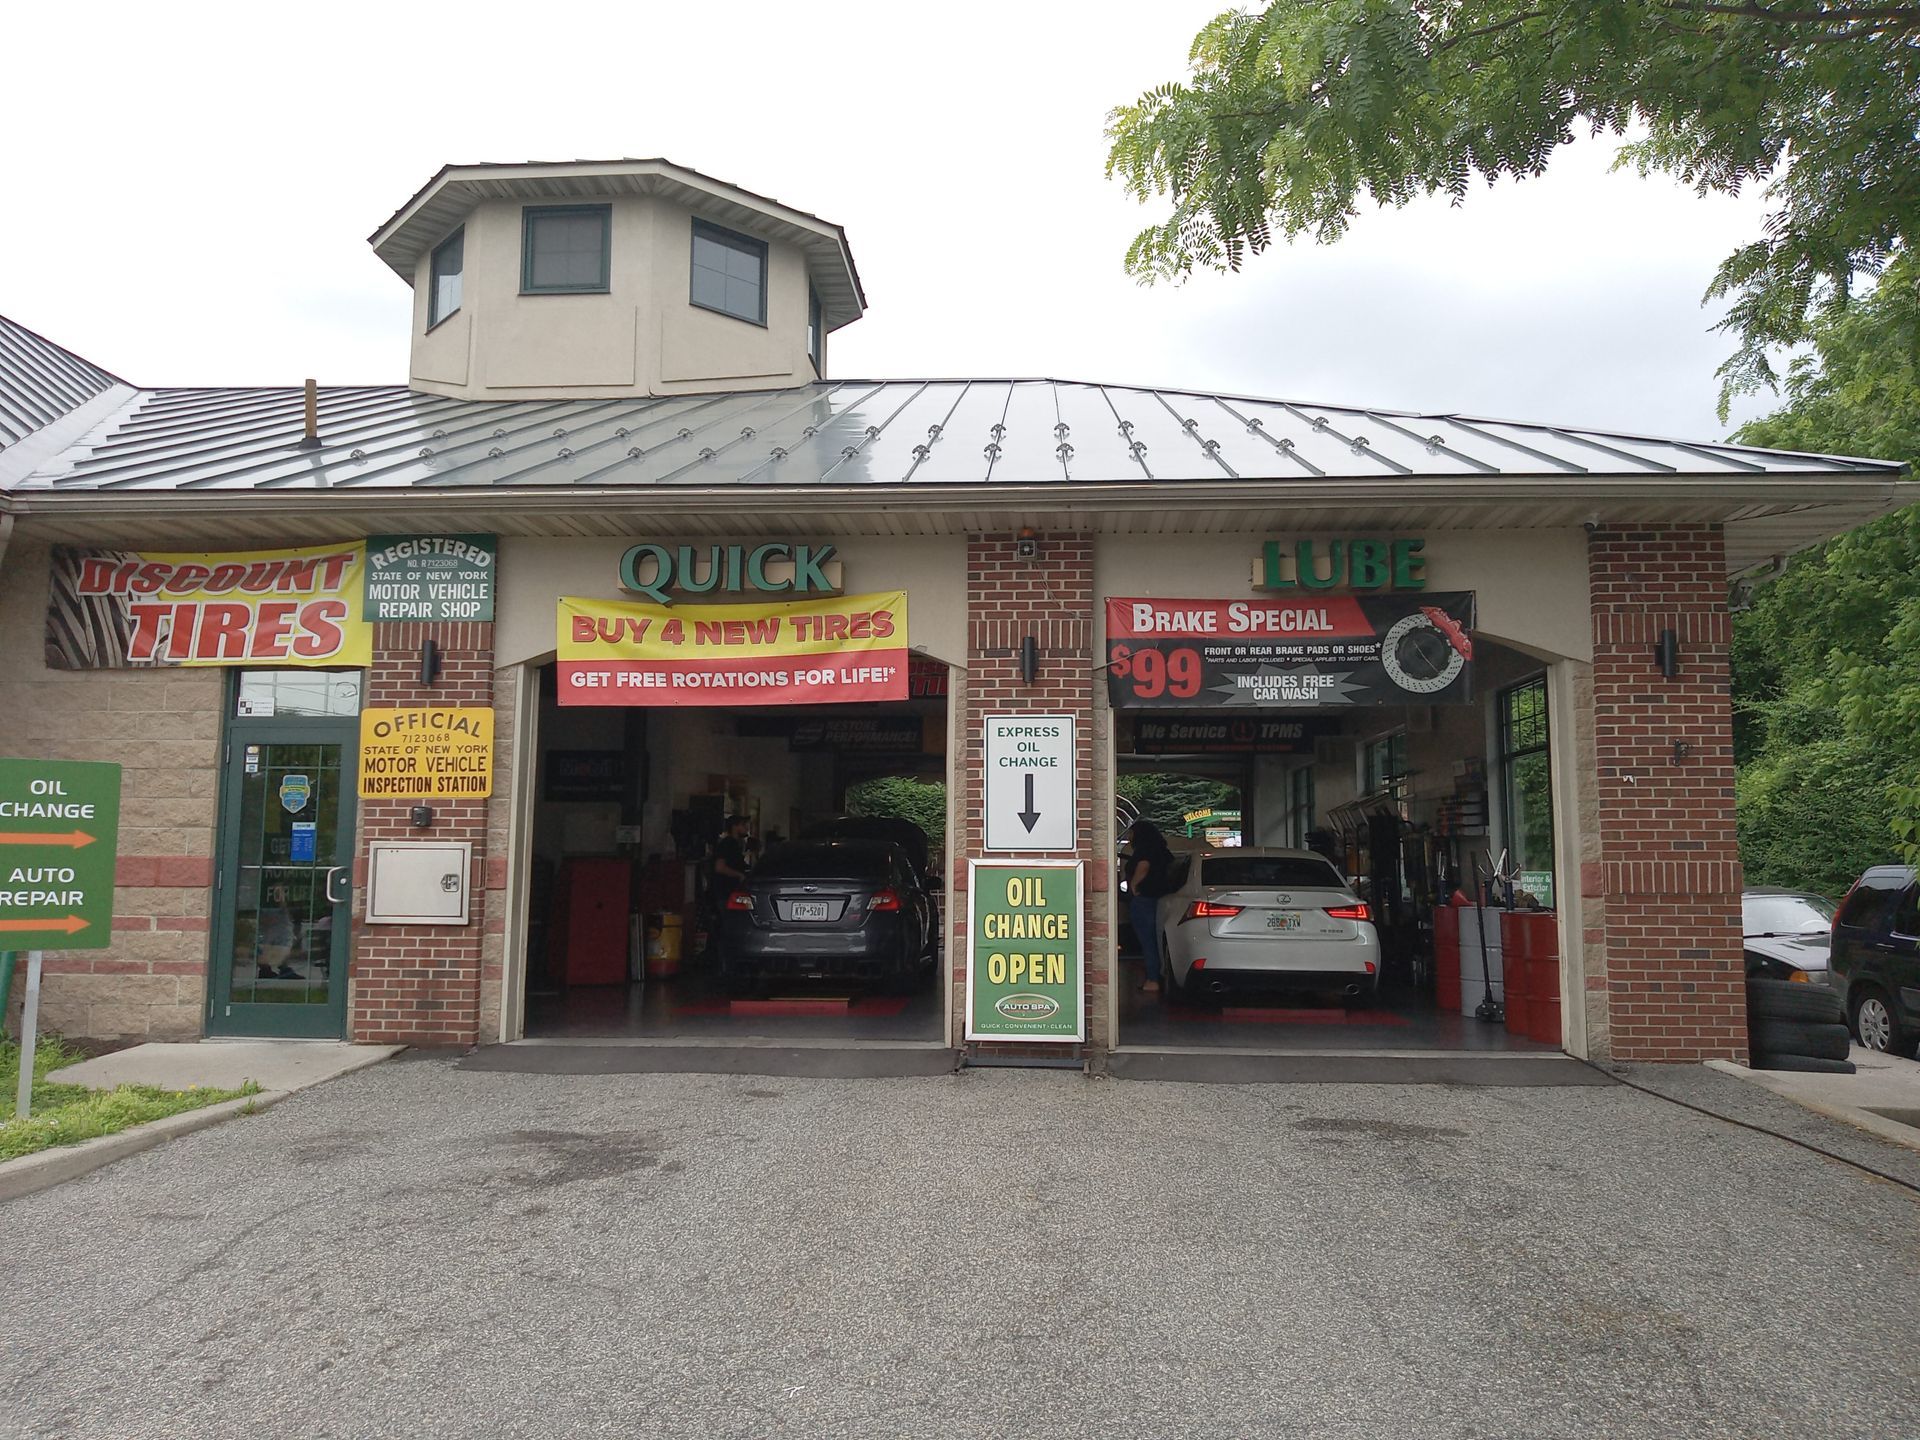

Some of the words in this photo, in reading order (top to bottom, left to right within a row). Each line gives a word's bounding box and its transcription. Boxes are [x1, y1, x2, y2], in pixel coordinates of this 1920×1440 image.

[370, 538, 491, 569] REGISTERED
[1262, 538, 1426, 590] LUBE
[77, 552, 356, 596] DISCOUNT
[371, 571, 401, 580] STATE
[406, 571, 421, 580] OF
[426, 571, 452, 580] NEW
[459, 571, 488, 580] YORK
[618, 542, 838, 607] QUICK
[369, 584, 420, 599] MOTOR
[428, 583, 489, 599] VEHICLE
[379, 602, 433, 618] REPAIR
[440, 601, 481, 618] SHOP
[127, 599, 347, 661] TIRES
[572, 615, 652, 643] BUY
[660, 618, 685, 645] 4
[694, 617, 781, 645] NEW
[789, 610, 895, 642] TIRES
[1204, 646, 1232, 656] FRONT
[1234, 646, 1247, 655] OR
[1250, 646, 1272, 655] REAR
[1275, 645, 1304, 655] BRAKE
[1307, 645, 1329, 655] PADS
[1332, 645, 1345, 654] OR
[570, 671, 611, 687] GET
[616, 672, 669, 687] FREE
[672, 671, 789, 688] ROTATIONS
[794, 668, 836, 686] FOR
[1110, 643, 1202, 698] $99
[1237, 676, 1298, 688] INCLUDES
[1302, 675, 1335, 688] FREE
[1253, 687, 1278, 700] CAR
[1281, 687, 1319, 700] WASH
[373, 712, 480, 738] OFFICIAL
[997, 726, 1060, 738] EXPRESS
[1140, 723, 1166, 739] We
[1170, 723, 1228, 739] Service
[1260, 723, 1304, 739] TPMS
[402, 733, 450, 743] 7123068
[1016, 741, 1040, 752] OIL
[364, 746, 400, 755] STATE
[405, 745, 420, 754] OF
[425, 745, 450, 754] NEW
[456, 744, 489, 753] YORK
[364, 757, 417, 773] MOTOR
[426, 756, 486, 772] VEHICLE
[998, 757, 1058, 767] CHANGE
[30, 780, 68, 796] OIL
[363, 776, 432, 793] INSPECTION
[437, 776, 487, 792] STATION
[0, 802, 95, 819] CHANGE
[1183, 808, 1212, 823] WELCOME
[9, 868, 75, 883] AUTO
[0, 891, 84, 906] REPAIR
[1006, 877, 1047, 907] OIL
[983, 913, 1070, 941] CHANGE
[987, 953, 1066, 985] OPEN
